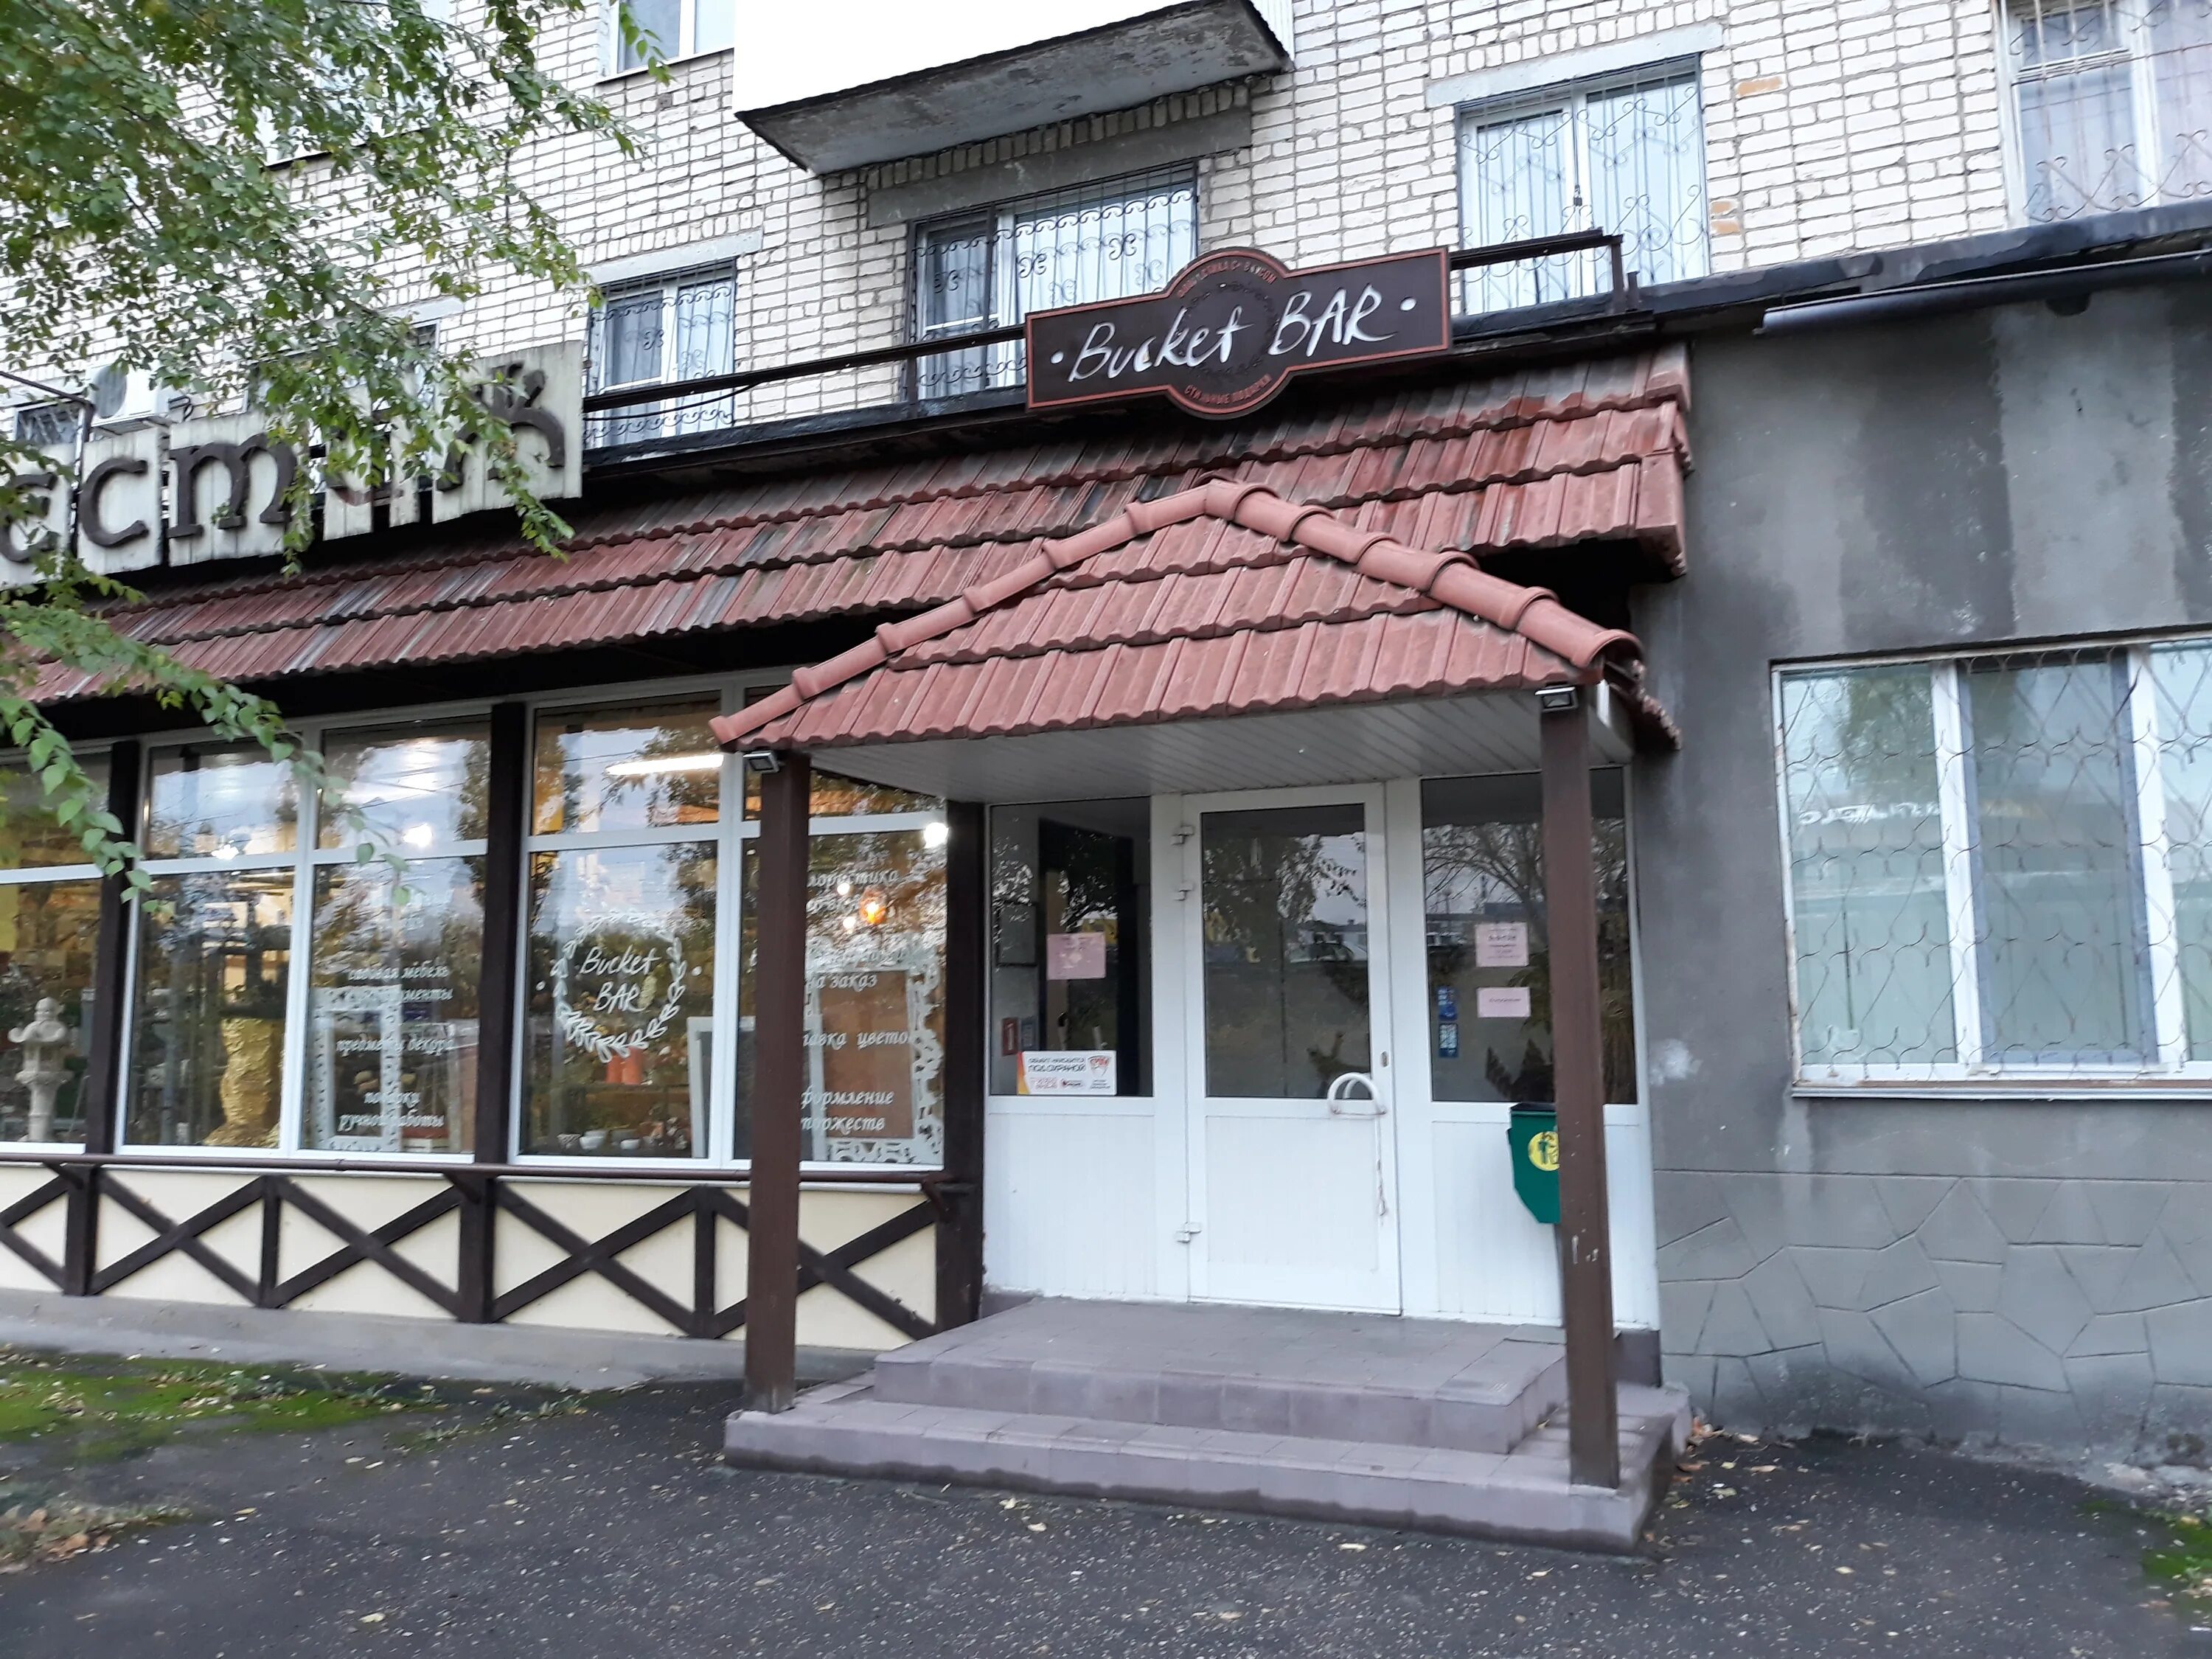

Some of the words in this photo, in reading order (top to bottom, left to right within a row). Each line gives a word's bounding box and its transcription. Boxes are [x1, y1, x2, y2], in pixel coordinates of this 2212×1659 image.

[1068, 306, 1253, 383] Bucket
[1267, 283, 1398, 357] BAR
[580, 945, 662, 975] Bucket
[829, 974, 877, 992] заказ
[593, 981, 647, 1014] BAR
[856, 1031, 914, 1051] цвето
[801, 1085, 894, 1110] формление
